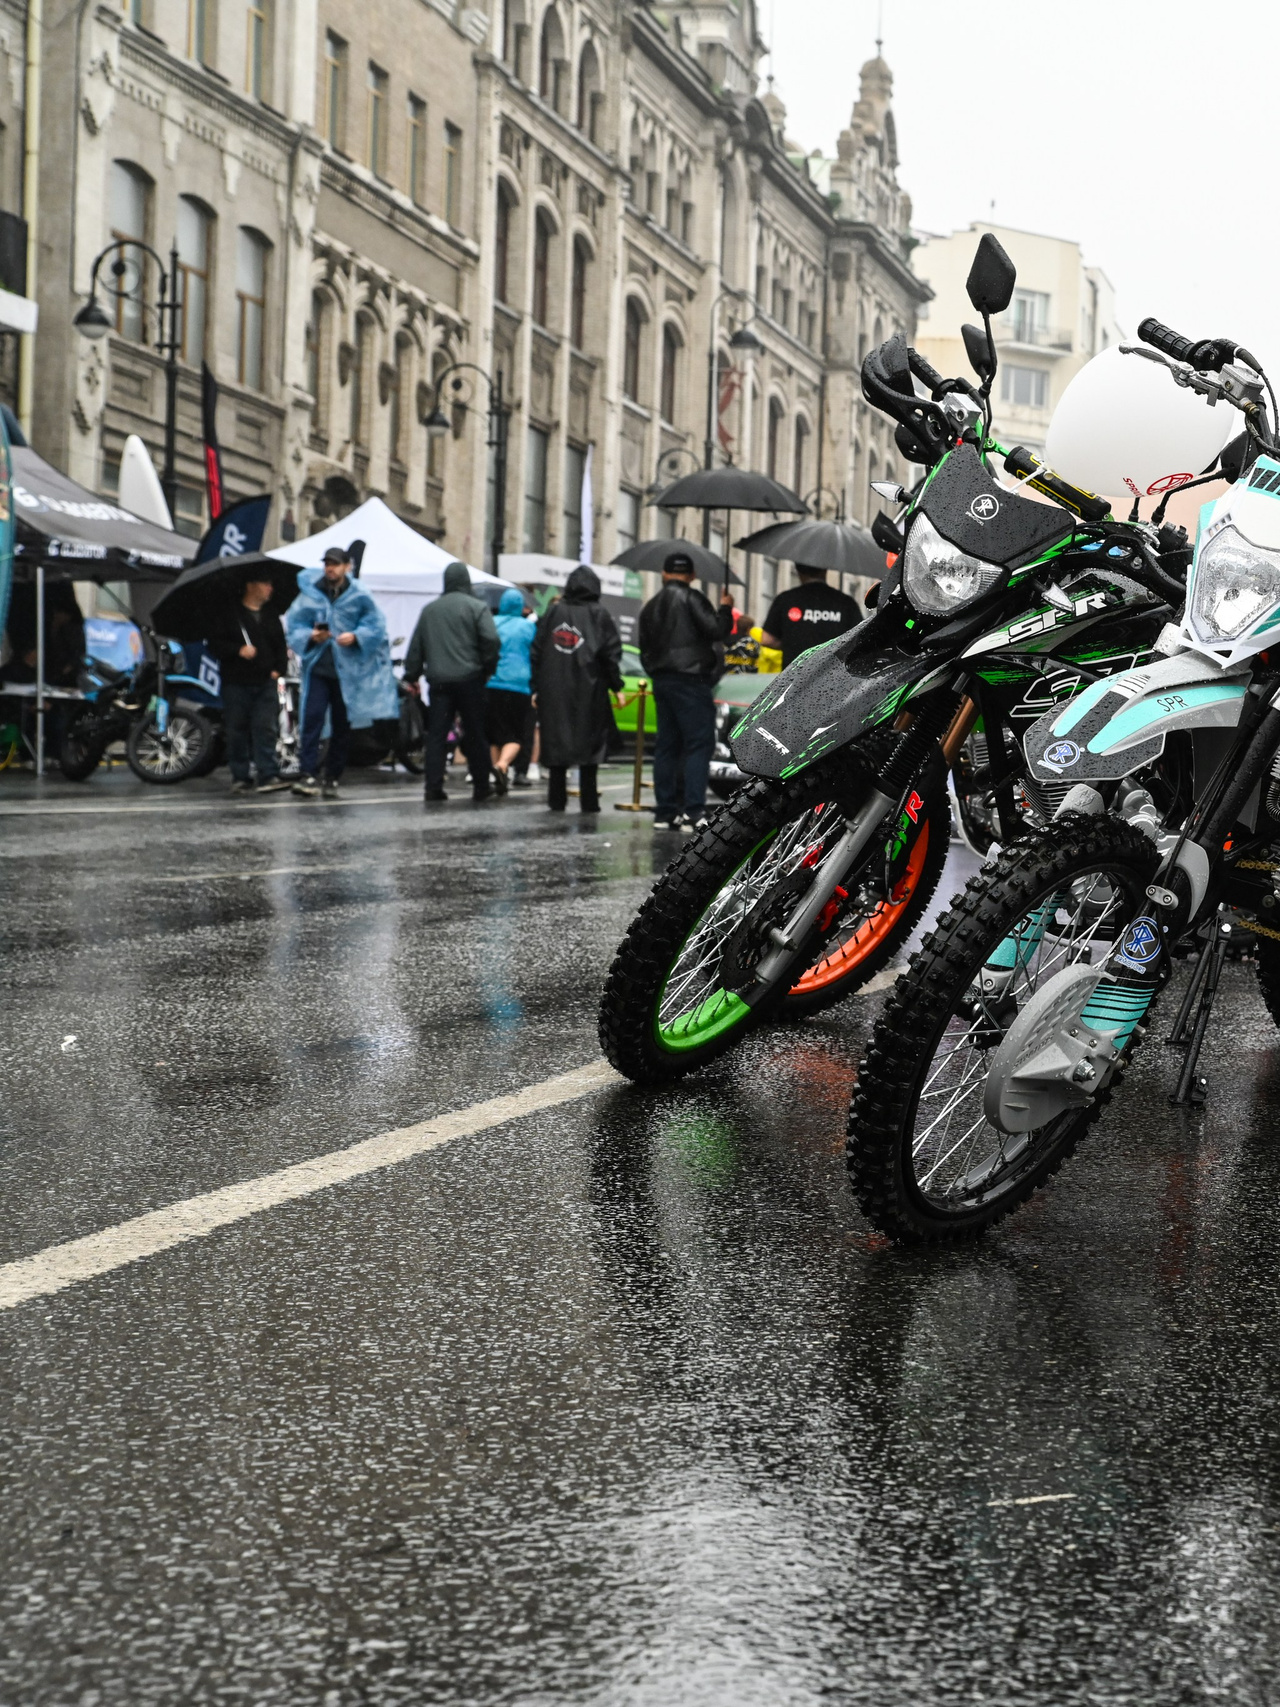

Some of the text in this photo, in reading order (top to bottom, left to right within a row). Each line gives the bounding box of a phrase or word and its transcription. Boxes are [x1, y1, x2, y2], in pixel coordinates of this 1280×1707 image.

[803, 608, 842, 623] дром
[1156, 694, 1189, 713] SPR
[755, 726, 790, 755] SPR
